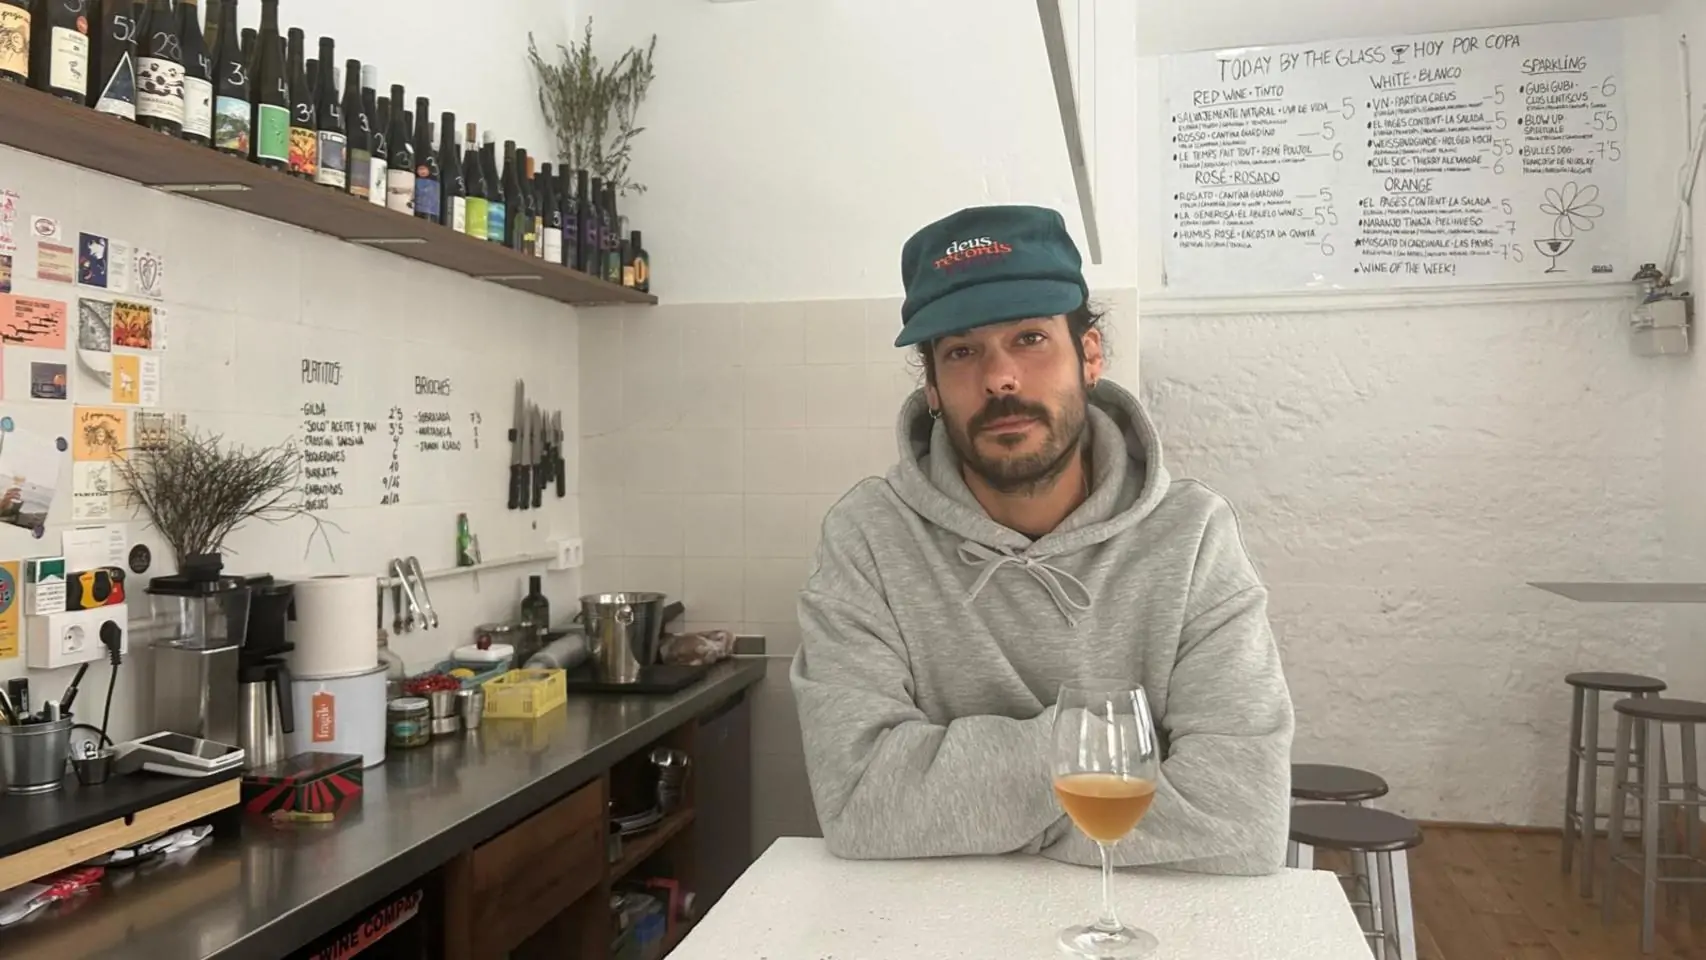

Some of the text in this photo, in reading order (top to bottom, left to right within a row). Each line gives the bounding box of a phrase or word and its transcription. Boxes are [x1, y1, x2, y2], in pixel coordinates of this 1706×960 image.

[113, 15, 138, 45] 52
[151, 31, 182, 60] 28
[1216, 34, 1520, 82] TODAY BY THE GLASS HOY POR COPA
[1522, 55, 1587, 72] SPARKLING
[1369, 67, 1462, 90] WHITE BLANCO
[1525, 75, 1616, 97] GUBI GUBI 6
[1193, 84, 1284, 106] RED WINE TINTO
[1493, 84, 1505, 105] 5
[1240, 105, 1276, 118] NATURAL
[1342, 96, 1356, 120] 5
[1495, 110, 1507, 130] 5
[1552, 114, 1564, 125] UP
[1177, 131, 1206, 143] ROSSO
[1322, 121, 1335, 140] 5
[1179, 151, 1189, 161] LE
[1332, 142, 1344, 162] 6
[1493, 157, 1505, 175] 6
[1234, 170, 1281, 185] ROSADO
[1384, 177, 1434, 192] ORANGE
[1319, 186, 1334, 202] 5
[1179, 209, 1190, 220] LA
[1362, 197, 1374, 208] EL
[1501, 198, 1512, 215] 5
[1504, 220, 1516, 235] 7
[946, 236, 993, 255] deus
[1179, 229, 1212, 239] HUMUS
[1320, 232, 1335, 257] 6
[933, 241, 1013, 269] records
[1360, 261, 1456, 276] WINE OF THE WEEK!
[303, 402, 326, 416] GILDA
[355, 421, 361, 433] Y
